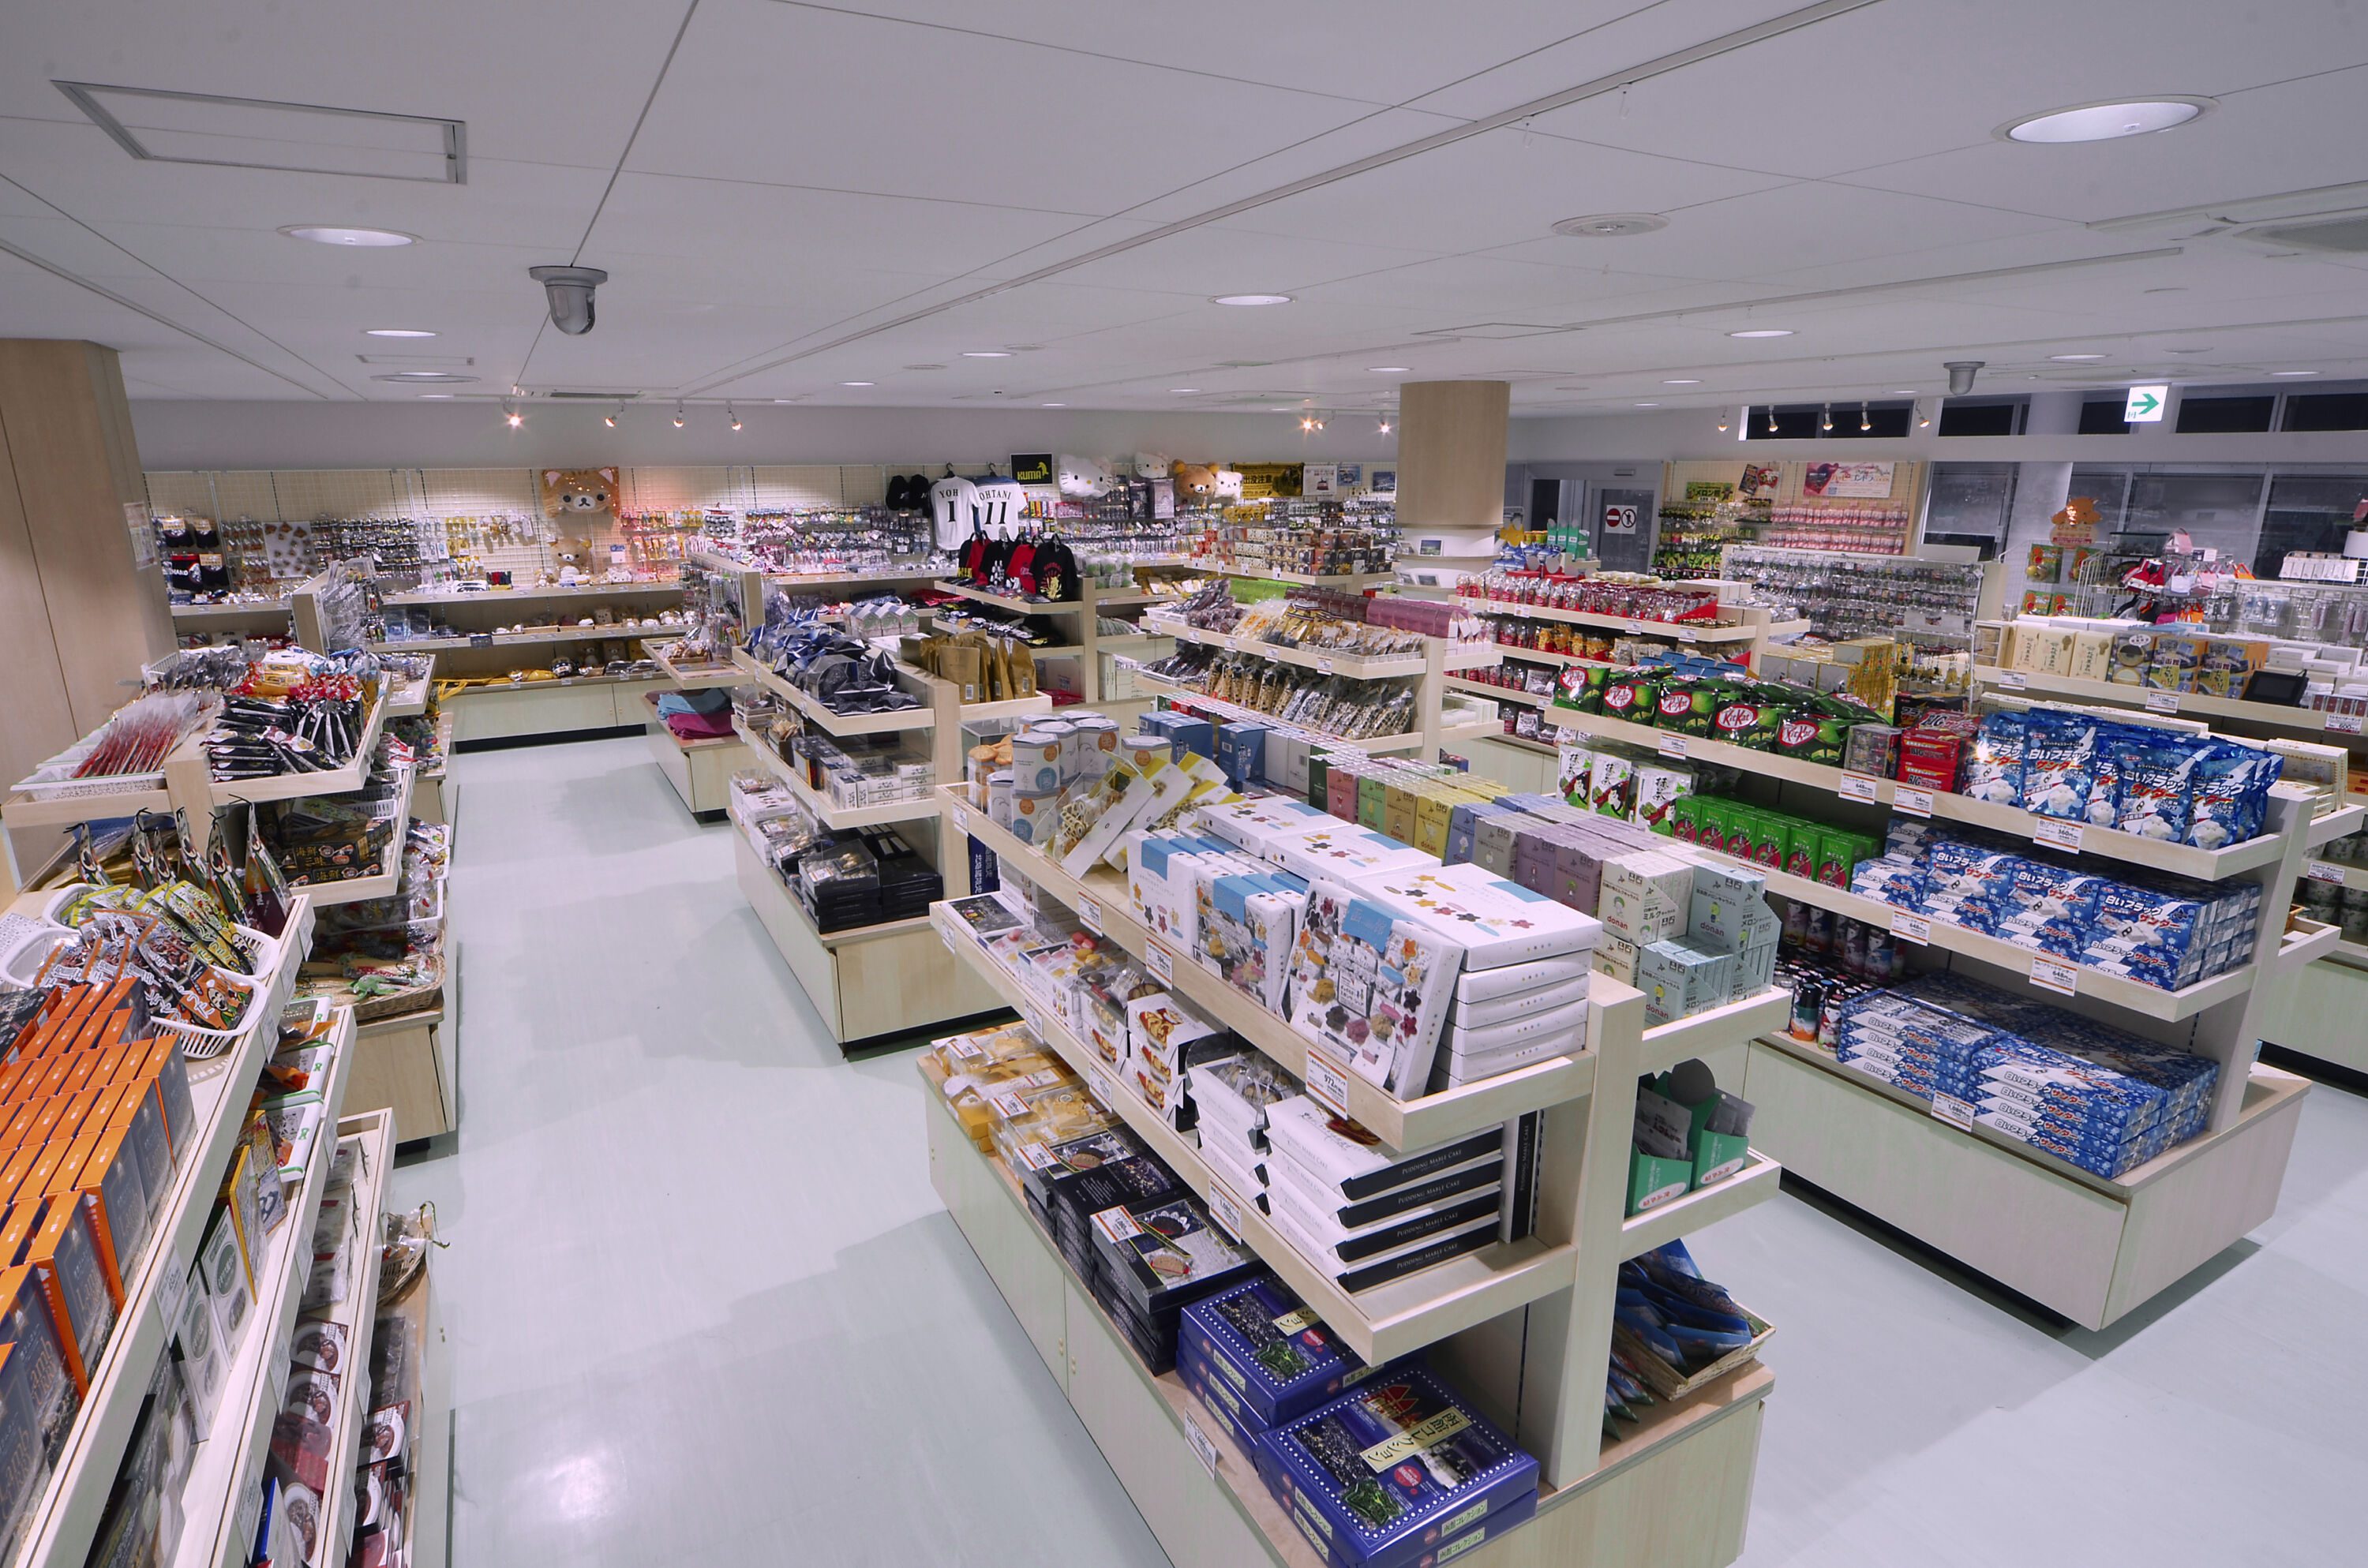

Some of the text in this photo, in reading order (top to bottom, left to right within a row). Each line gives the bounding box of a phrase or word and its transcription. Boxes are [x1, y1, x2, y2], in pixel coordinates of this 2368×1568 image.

[1017, 470, 1042, 481] KUMA
[939, 488, 958, 499] YOH
[979, 489, 1012, 501] OHTANI
[947, 500, 957, 522] 1
[984, 501, 1007, 525] 11
[1666, 694, 1689, 710] KitKat
[1722, 709, 1750, 725] KitKat
[1786, 725, 1813, 742] KitKat
[2029, 749, 2092, 764] 白いブラック
[2036, 760, 2084, 771] サンダー
[1907, 774, 1921, 786] BIG
[2124, 770, 2187, 791] 白いブラック
[2131, 784, 2179, 799] サンダー
[1936, 851, 1985, 869] 白いブラック
[1965, 867, 2000, 881] サンダー
[2018, 870, 2070, 891] 白いブラック
[2048, 888, 2085, 904] サンダー
[2105, 894, 2162, 916] 白いブラック
[1606, 915, 1628, 930] donan
[1700, 922, 1724, 937] donan
[2139, 914, 2181, 930] サンダー
[1645, 1003, 1669, 1020] donan
[2004, 1071, 2088, 1106] 白いブラックサンダー
[2001, 1086, 2083, 1123] 白いブラックサンダー
[1999, 1102, 2080, 1140] 白いブラックサンダー
[1995, 1118, 2075, 1156] 白いブラックサンダー
[1402, 1149, 1463, 1174] PUDDING MABLE CAKE
[1398, 1180, 1460, 1204] PUDDING MABLE CAKE
[1396, 1211, 1459, 1237] PUDDING MABLE CAKE
[1396, 1243, 1459, 1269] PUDDING MABLE CAKE
[1368, 1413, 1461, 1463] 函館コレクション
[1296, 1489, 1332, 1536] 函館コレクション
[1443, 1502, 1486, 1535] 函館コレクション
[1295, 1510, 1328, 1559] 函館コレクション
[1439, 1529, 1483, 1561] 函館コレクション
